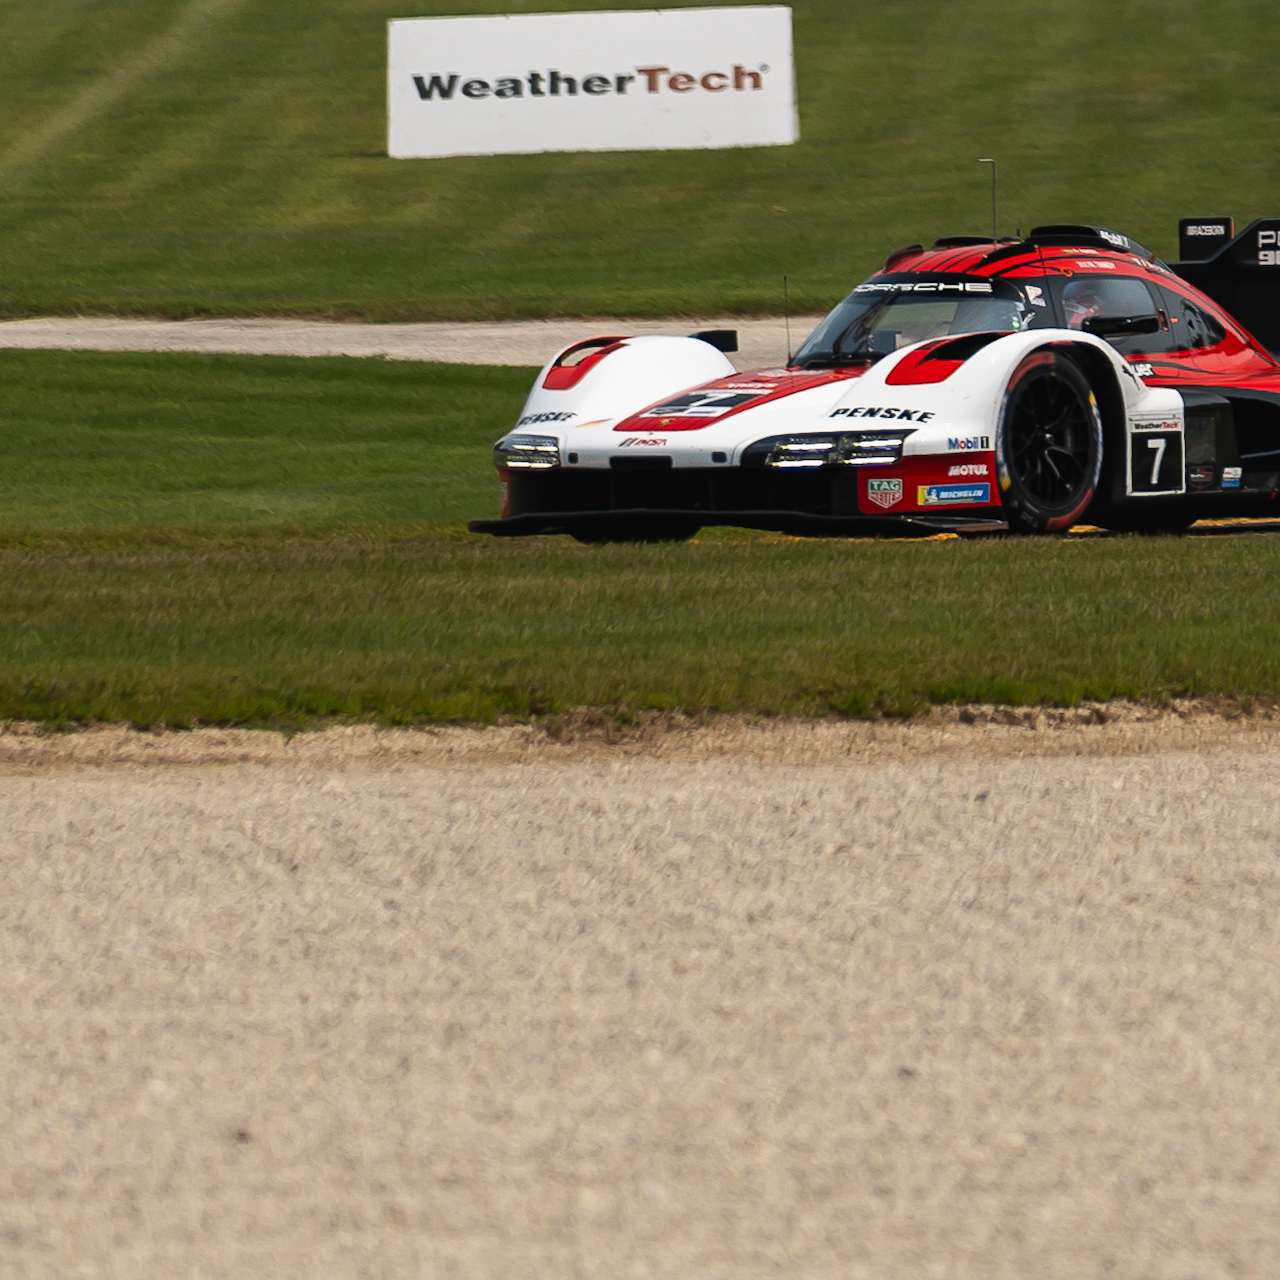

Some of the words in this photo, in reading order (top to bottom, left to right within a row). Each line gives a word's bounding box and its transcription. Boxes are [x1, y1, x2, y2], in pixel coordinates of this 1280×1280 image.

[411, 64, 765, 101] WeatherTech
[855, 282, 994, 293] ORSCHE
[829, 407, 936, 424] PENSKE
[948, 436, 979, 450] Mobil
[980, 436, 989, 449] 1
[1147, 438, 1167, 485] 7
[948, 464, 989, 477] MOTUL
[871, 480, 900, 491] TAG
